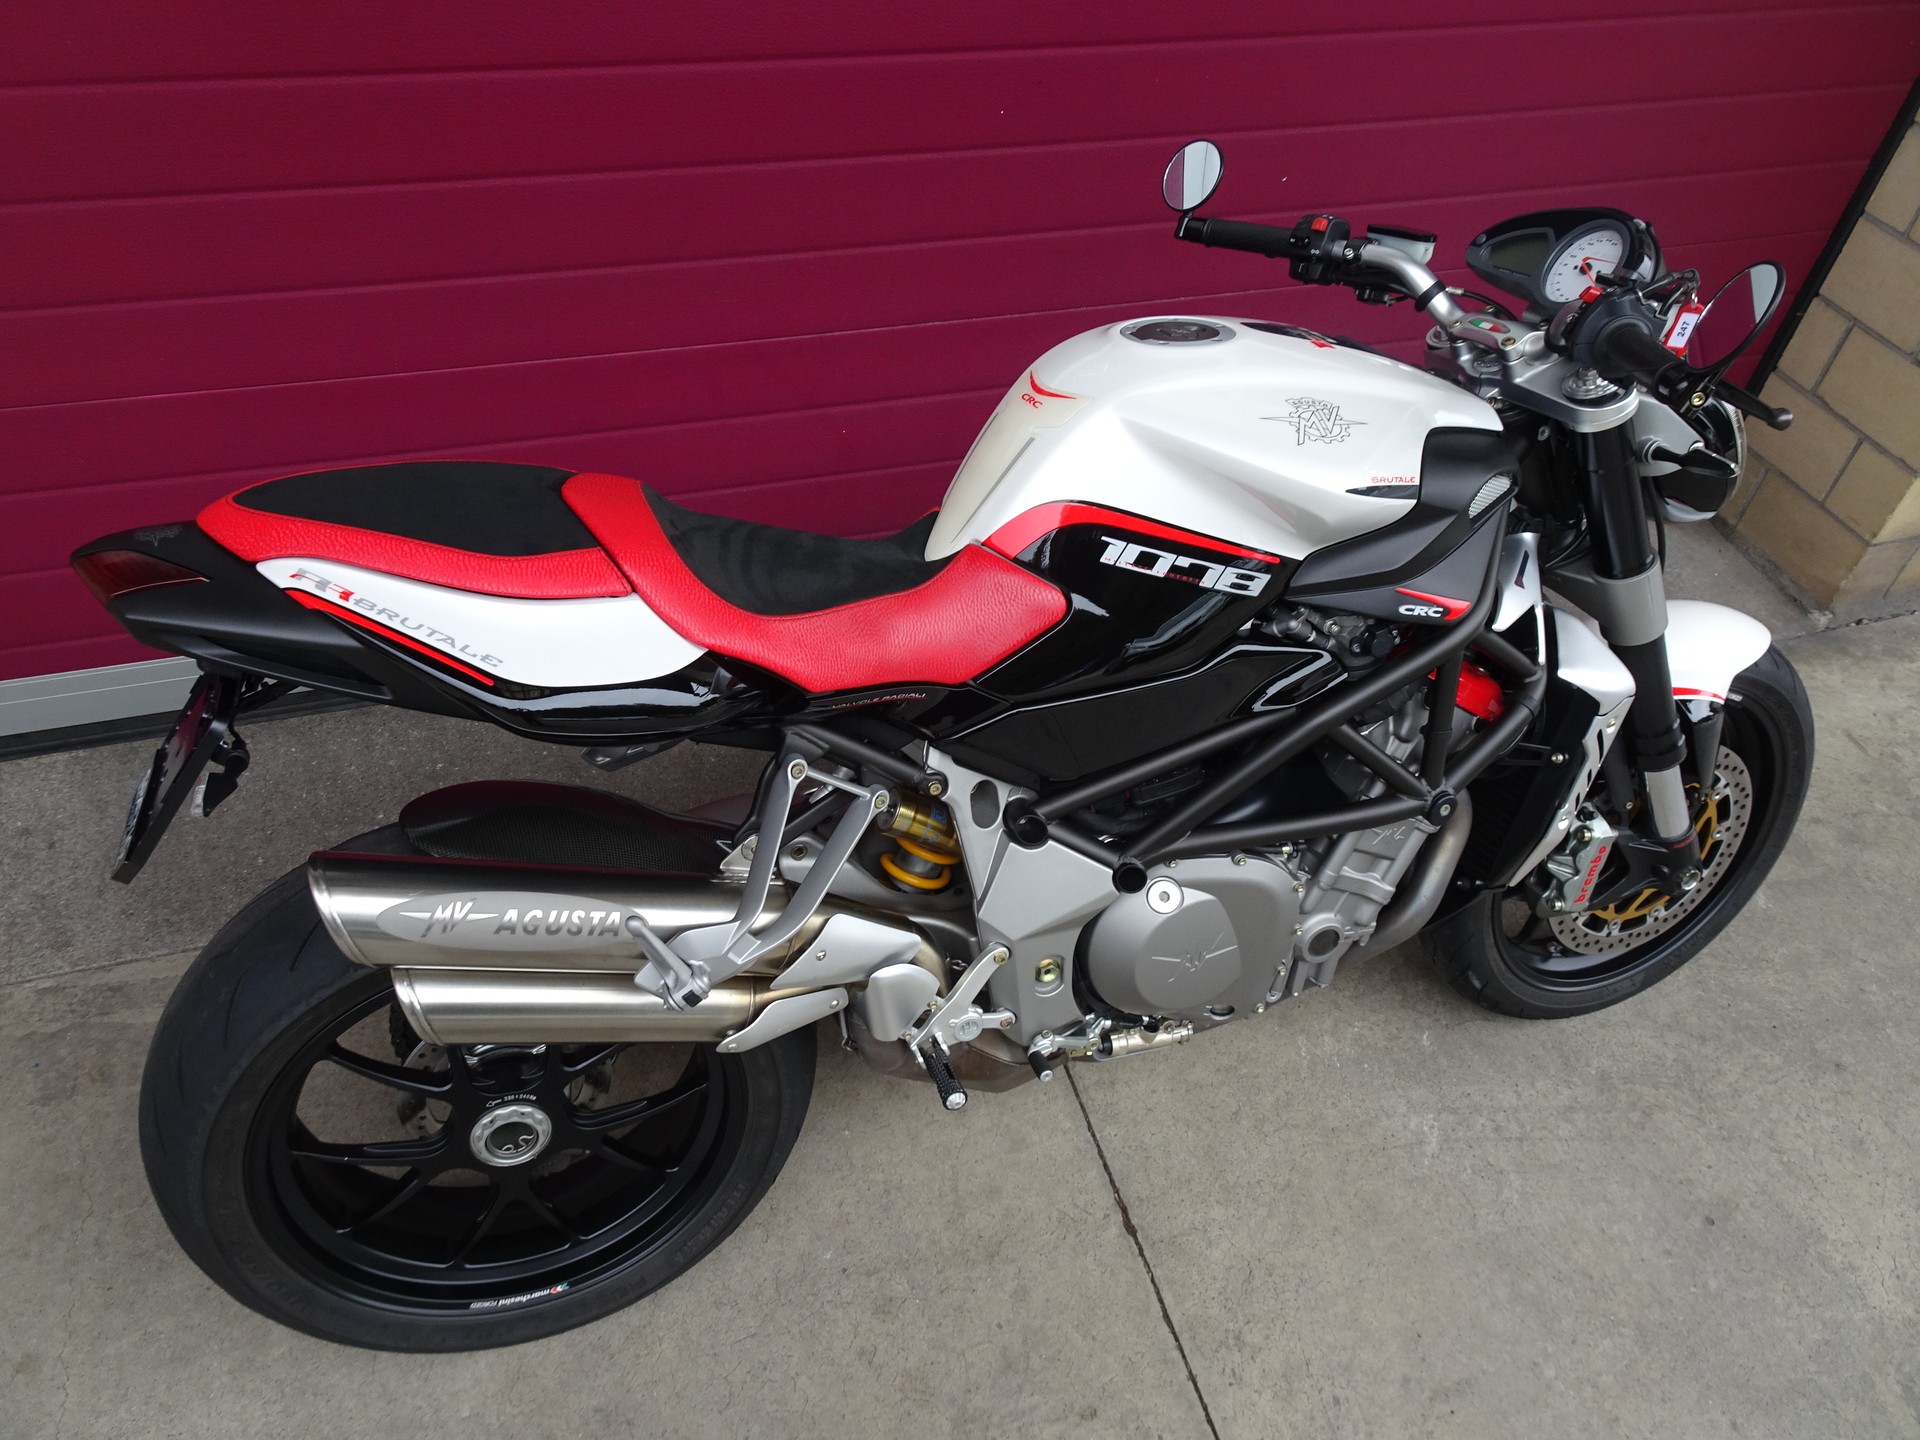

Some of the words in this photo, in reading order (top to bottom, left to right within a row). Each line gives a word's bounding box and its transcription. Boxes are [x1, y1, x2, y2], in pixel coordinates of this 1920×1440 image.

[1677, 321, 1690, 337] 247
[1021, 393, 1043, 409] CRC
[1371, 476, 1416, 484] BRUTALE
[1099, 535, 1272, 598] 1078
[1398, 604, 1444, 618] CRC
[353, 597, 504, 668] BRUTALE
[881, 692, 927, 702] RADIALI
[1574, 845, 1608, 904] brembo
[493, 908, 621, 937] AGUSTA
[498, 1288, 550, 1307] marchesini
